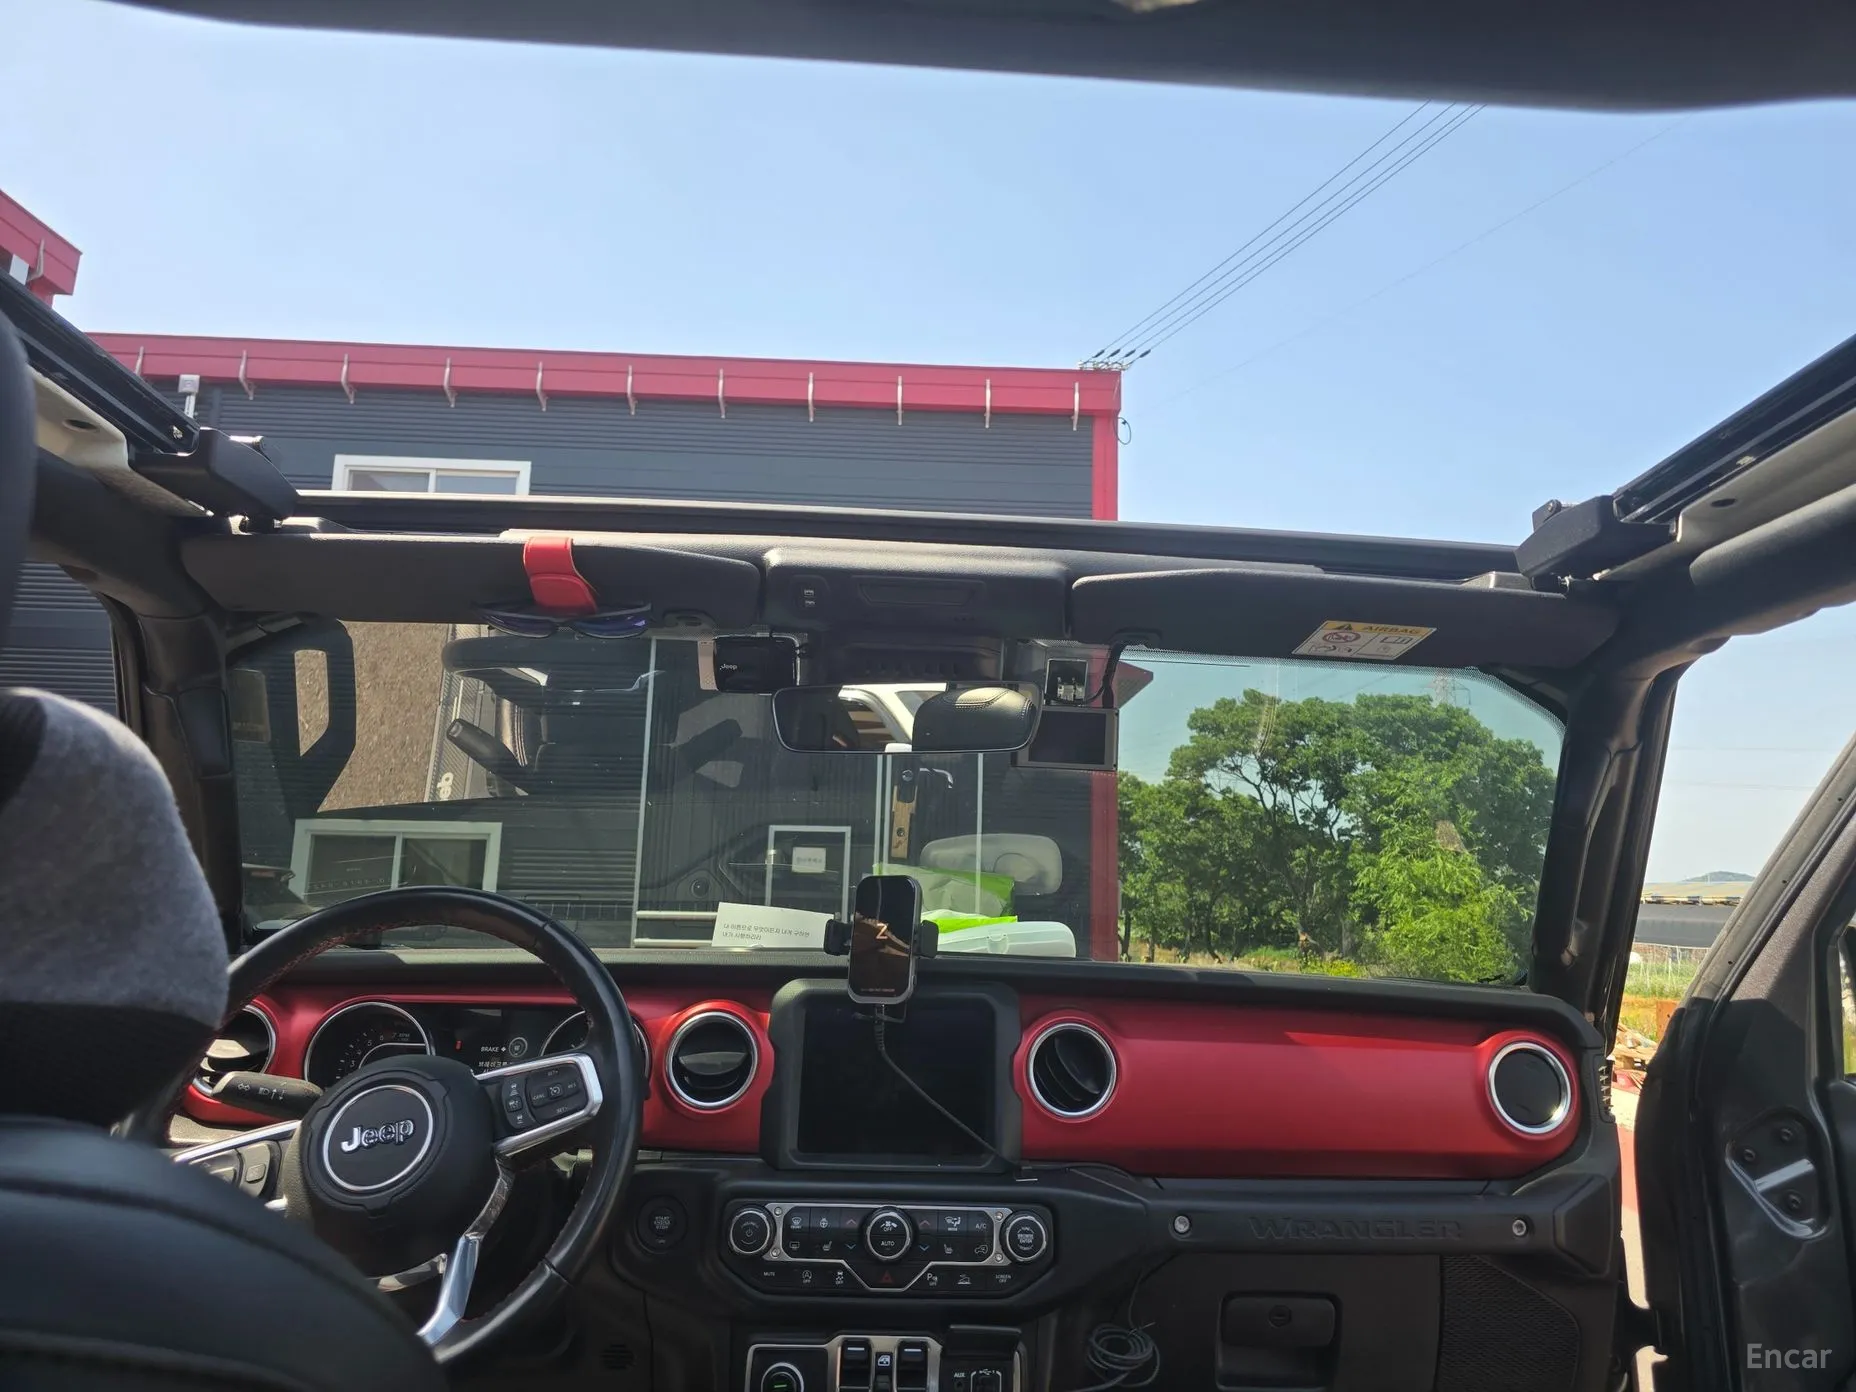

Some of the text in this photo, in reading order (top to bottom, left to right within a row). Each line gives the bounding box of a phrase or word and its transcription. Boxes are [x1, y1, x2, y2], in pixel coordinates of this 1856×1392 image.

[1363, 625, 1423, 635] AIRBAG
[340, 1118, 414, 1153] Jeep
[1249, 1214, 1463, 1242] WRANGLER
